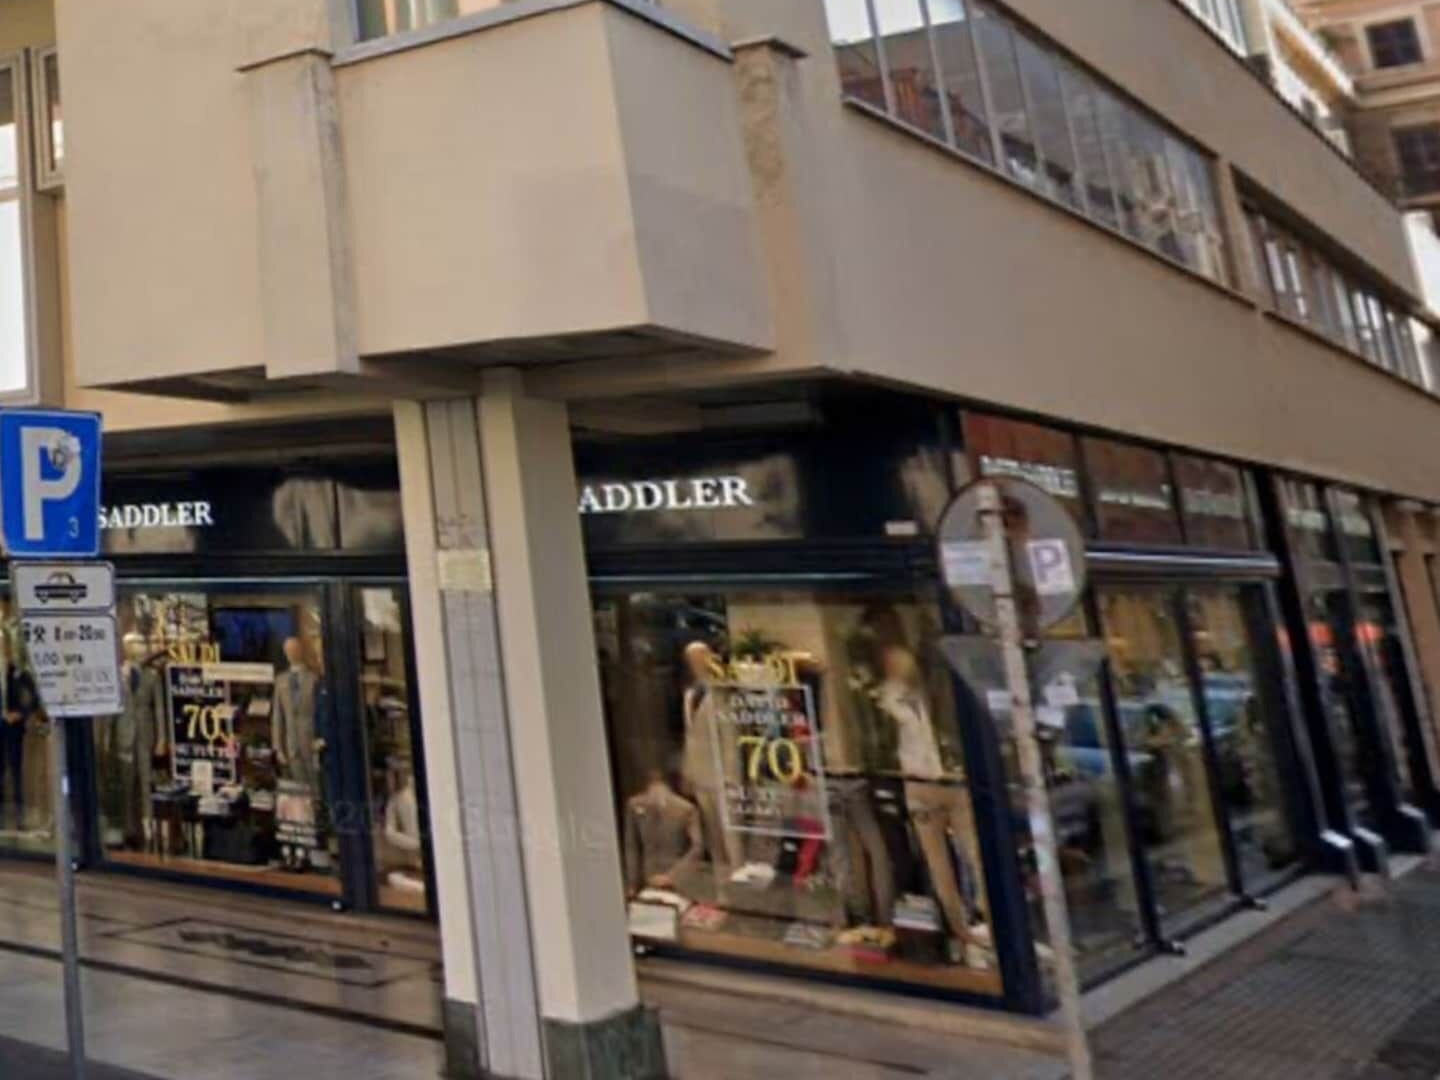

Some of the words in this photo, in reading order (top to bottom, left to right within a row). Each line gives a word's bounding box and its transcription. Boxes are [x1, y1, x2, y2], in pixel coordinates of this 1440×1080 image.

[19, 426, 82, 540] P
[578, 476, 753, 514] ADDLER
[737, 736, 801, 783] 70
